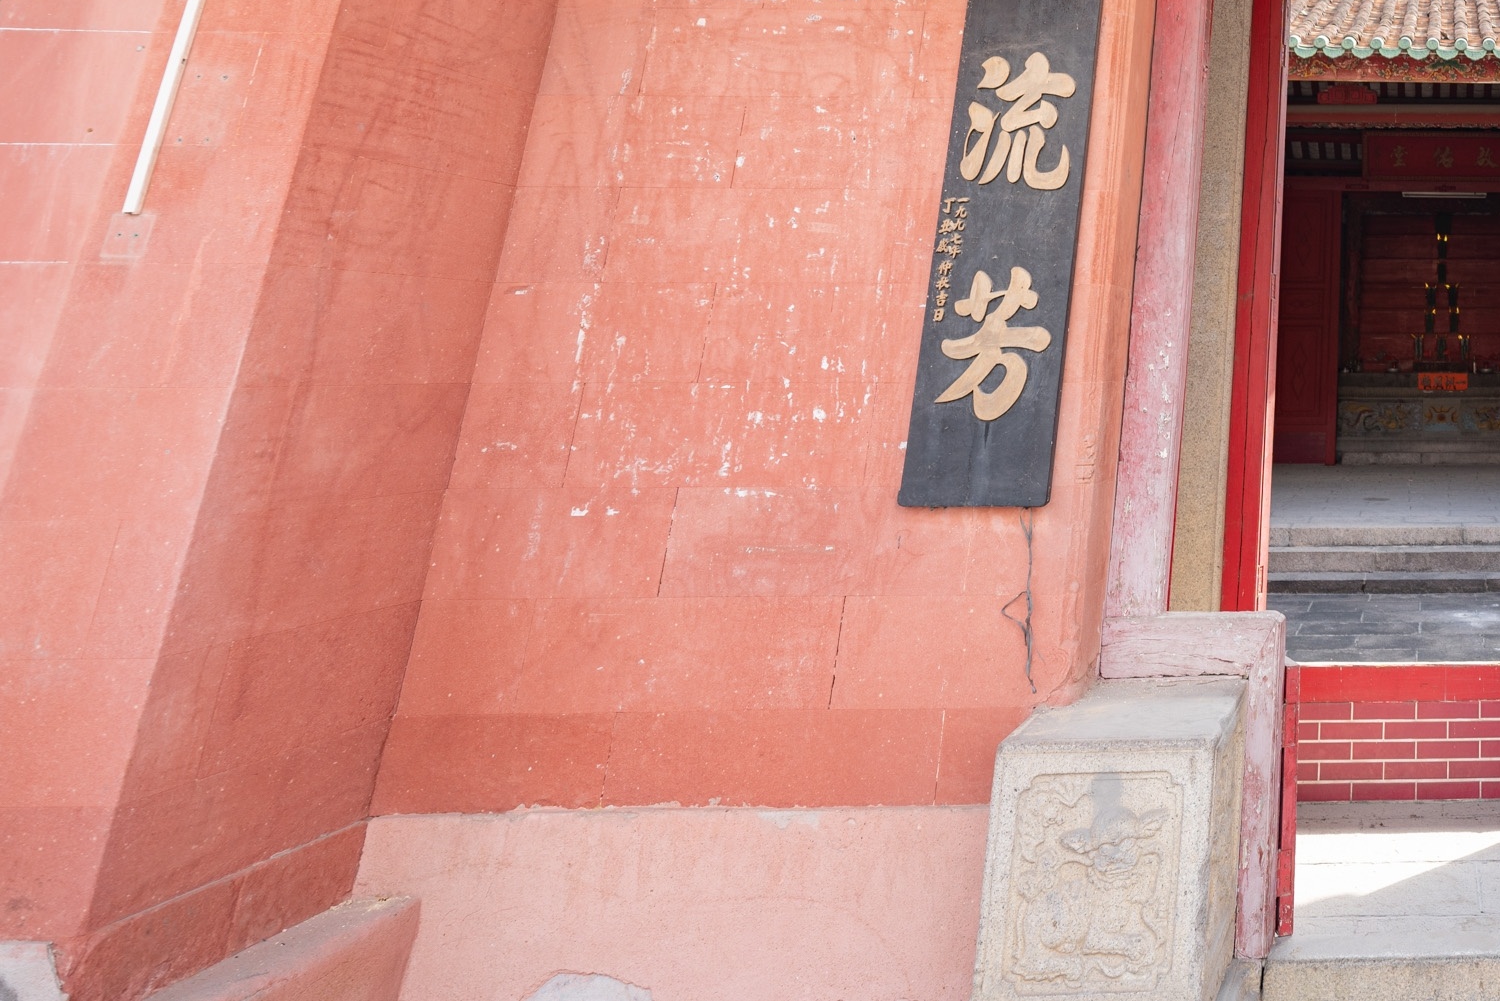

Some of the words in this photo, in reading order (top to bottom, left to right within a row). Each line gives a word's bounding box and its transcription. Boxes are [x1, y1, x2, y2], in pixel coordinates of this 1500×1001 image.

[948, 197, 970, 259] 一九九七年
